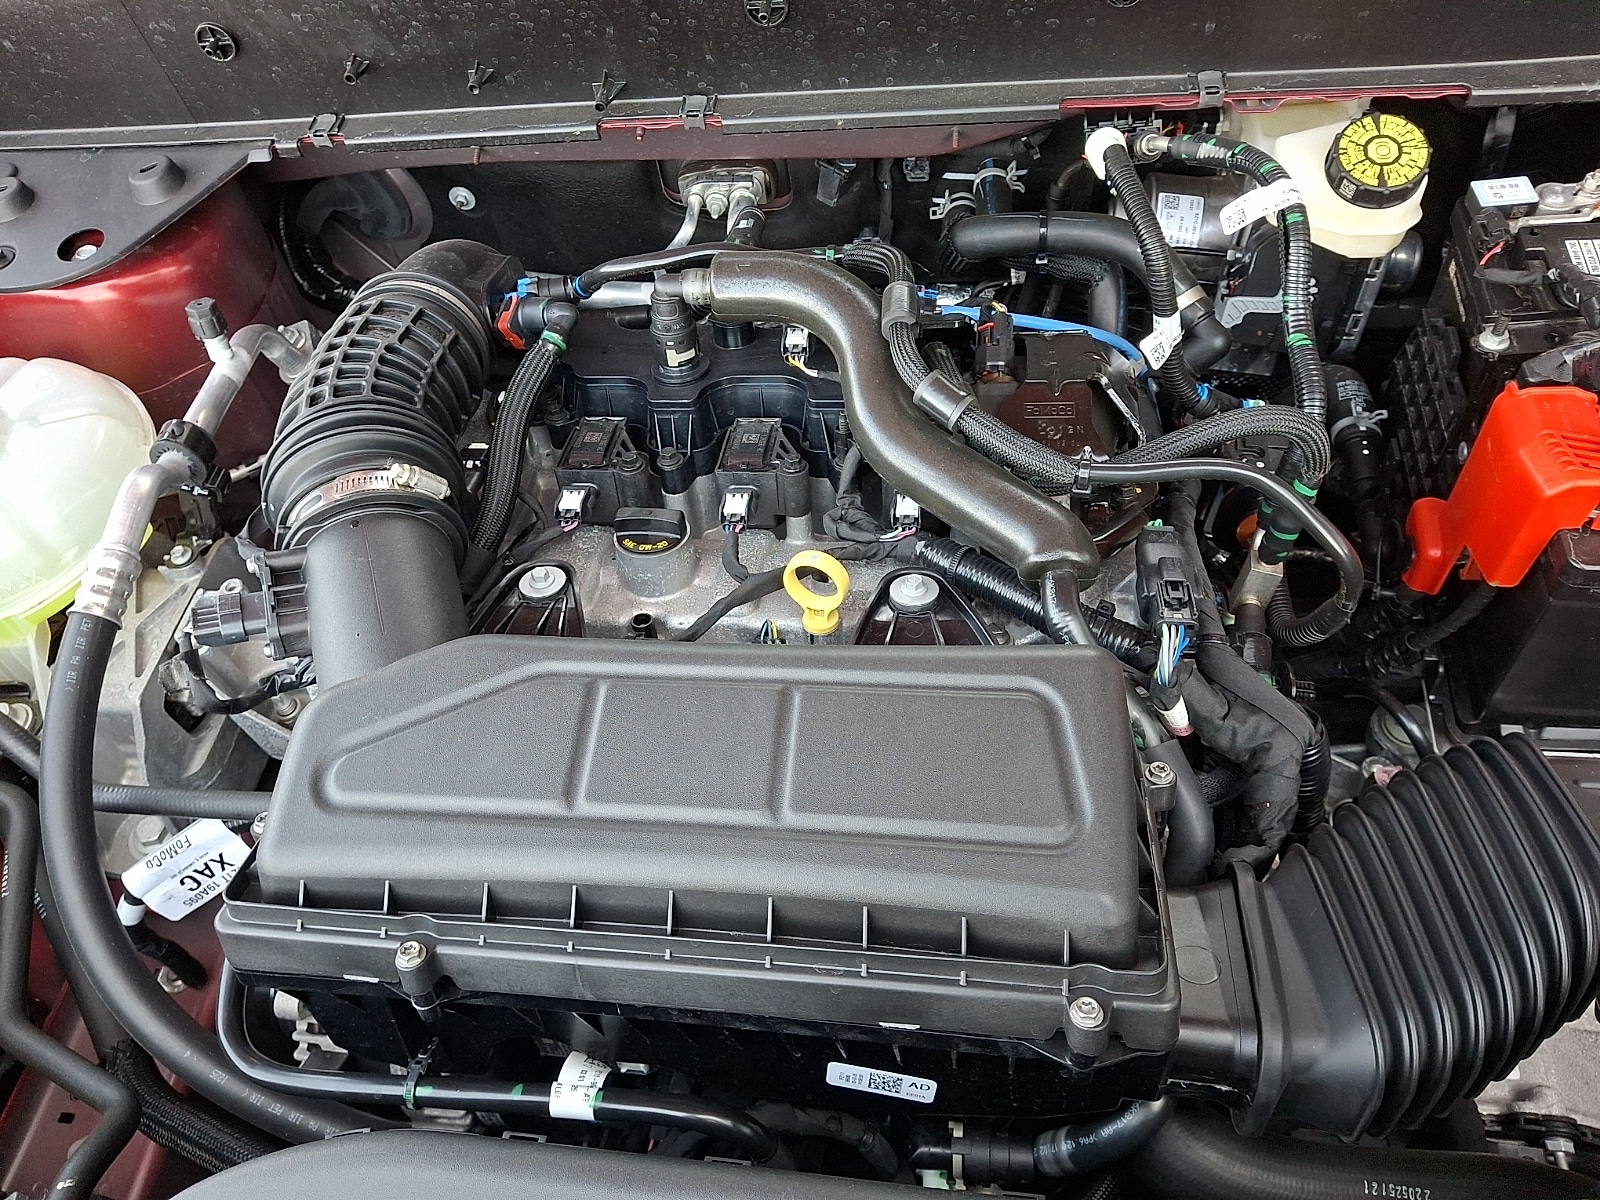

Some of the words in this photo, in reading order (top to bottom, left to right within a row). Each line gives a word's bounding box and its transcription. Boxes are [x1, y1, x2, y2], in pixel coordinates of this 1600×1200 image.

[1025, 405, 1073, 414] FoMoCo
[622, 538, 636, 548] SAE
[638, 540, 668, 550] 0W-20
[69, 654, 81, 665] PA
[79, 617, 92, 631] PET
[144, 834, 192, 870] FoMoCo
[179, 852, 235, 891] XAC
[182, 880, 220, 908] 19A095
[908, 1082, 930, 1091] AD
[267, 1100, 285, 1116] PET
[307, 1119, 320, 1132] PA
[1363, 1179, 1430, 1200] 220525121
